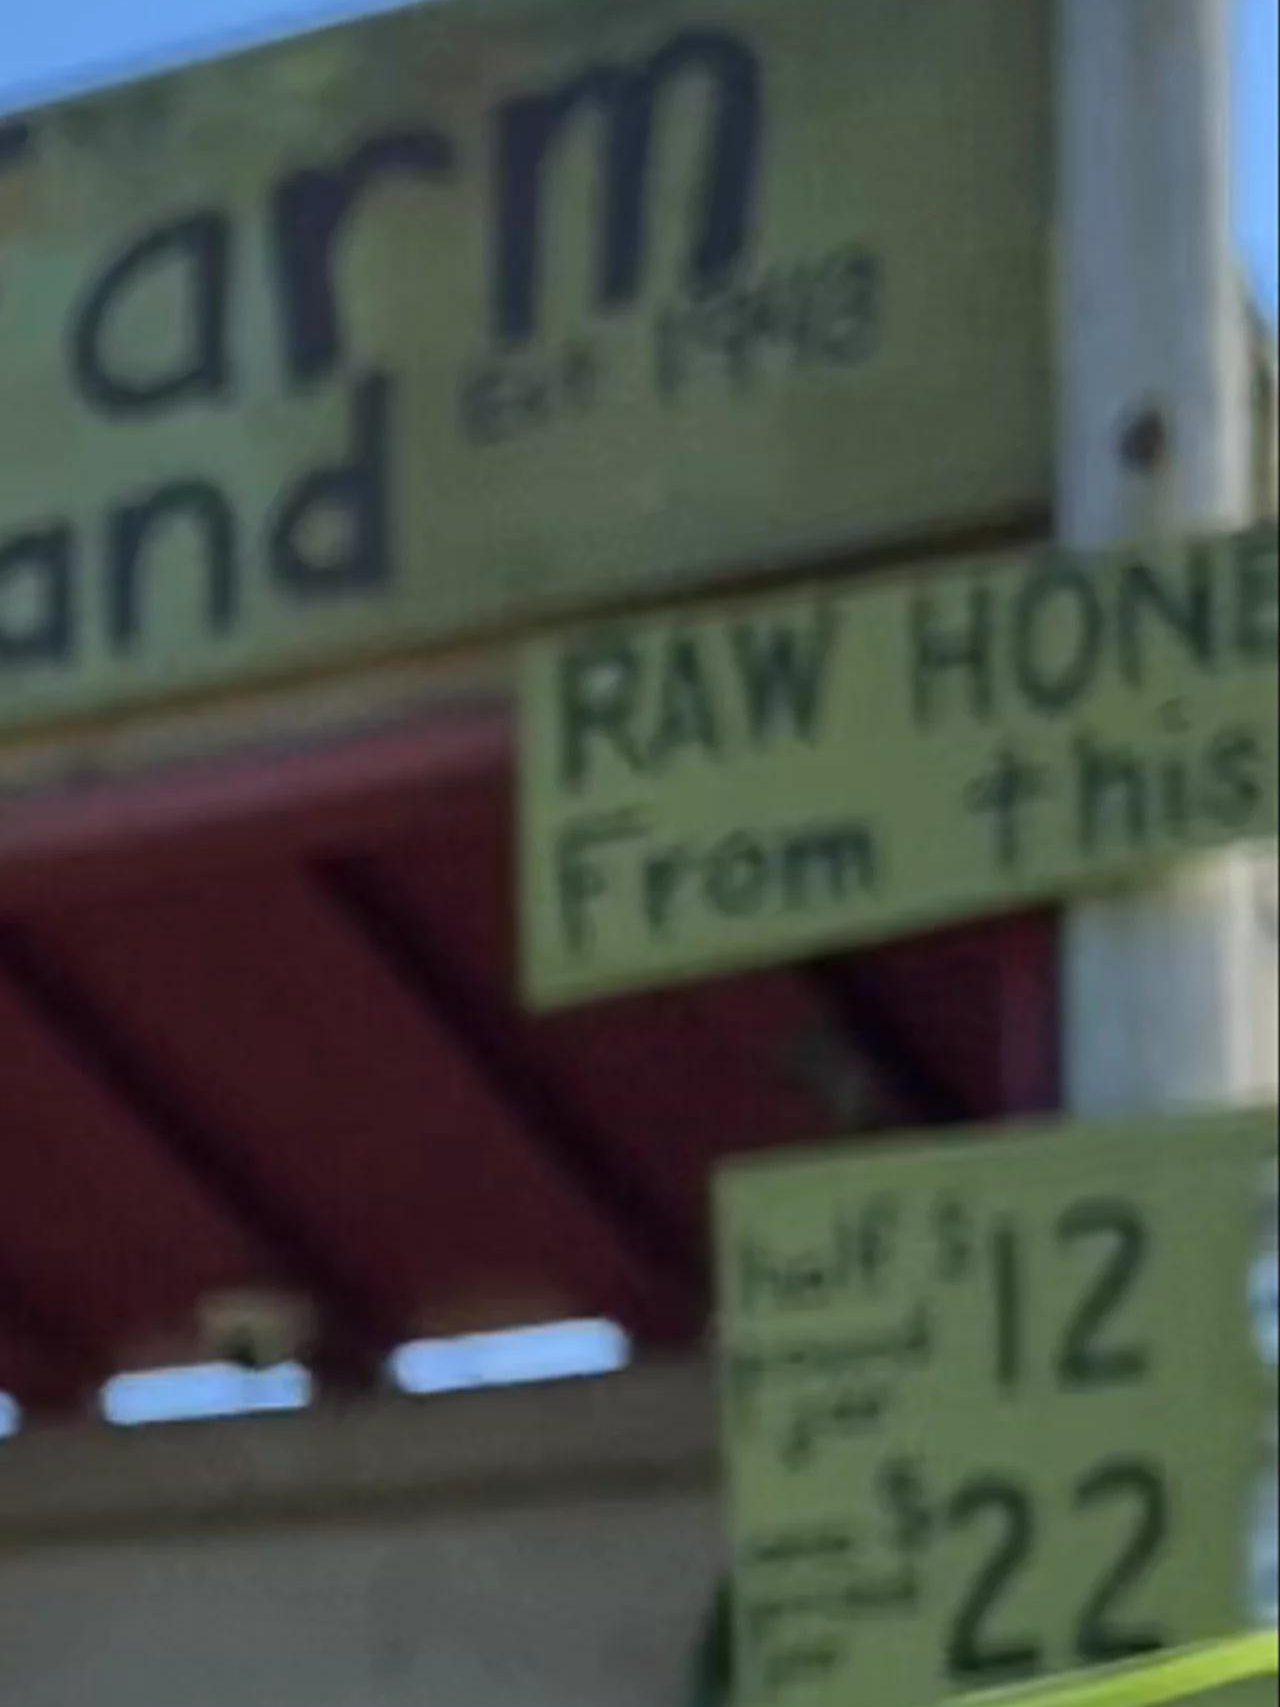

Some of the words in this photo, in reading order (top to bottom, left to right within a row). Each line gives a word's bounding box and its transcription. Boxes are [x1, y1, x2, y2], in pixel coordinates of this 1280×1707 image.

[552, 595, 834, 796] RAW
[555, 805, 880, 957] From
[965, 698, 1266, 873] this
[930, 1187, 1154, 1401] $12
[876, 1453, 1172, 1680] $22
